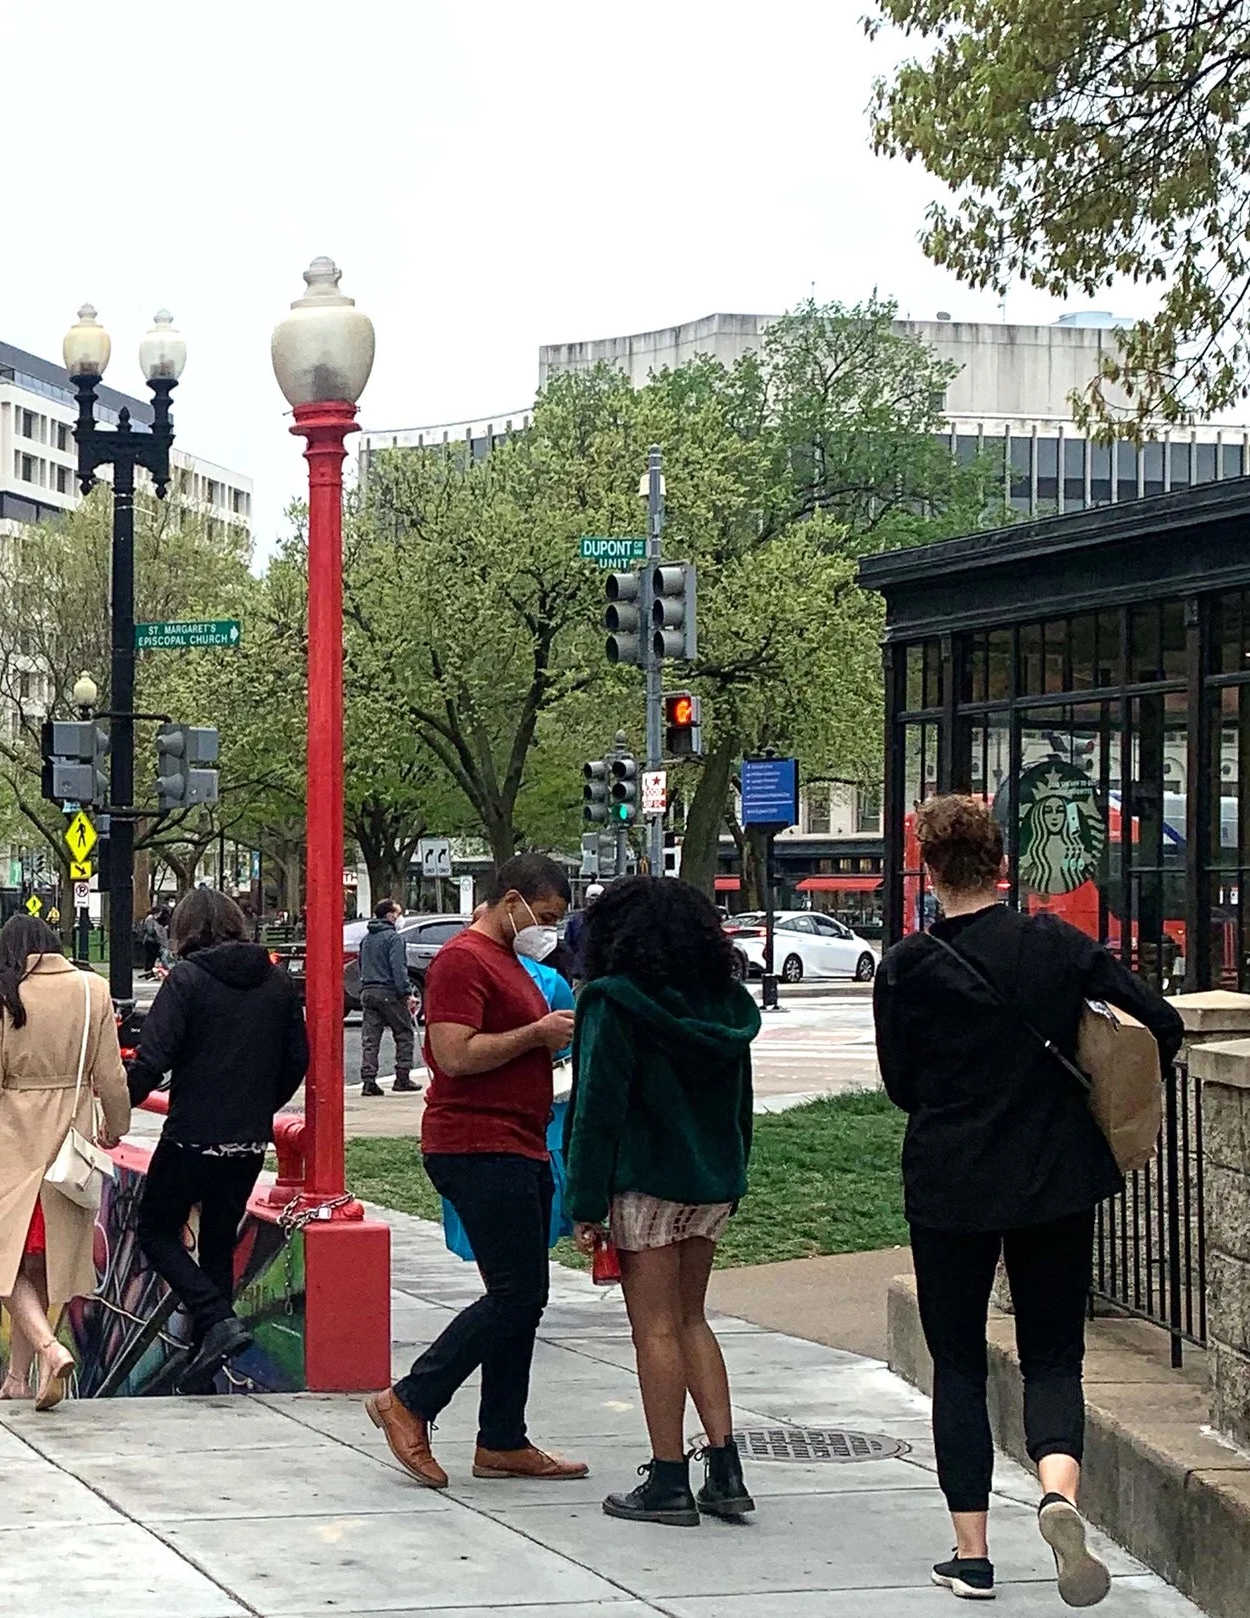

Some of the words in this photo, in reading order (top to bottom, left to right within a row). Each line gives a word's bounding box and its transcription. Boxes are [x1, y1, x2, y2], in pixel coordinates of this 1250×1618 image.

[583, 540, 632, 556] DUPONT
[599, 558, 629, 568] UNIT
[148, 626, 161, 636] ST.
[164, 624, 216, 634] MARGARET'S
[138, 636, 186, 646] EPISCOPAL
[189, 634, 228, 644] CHURCH
